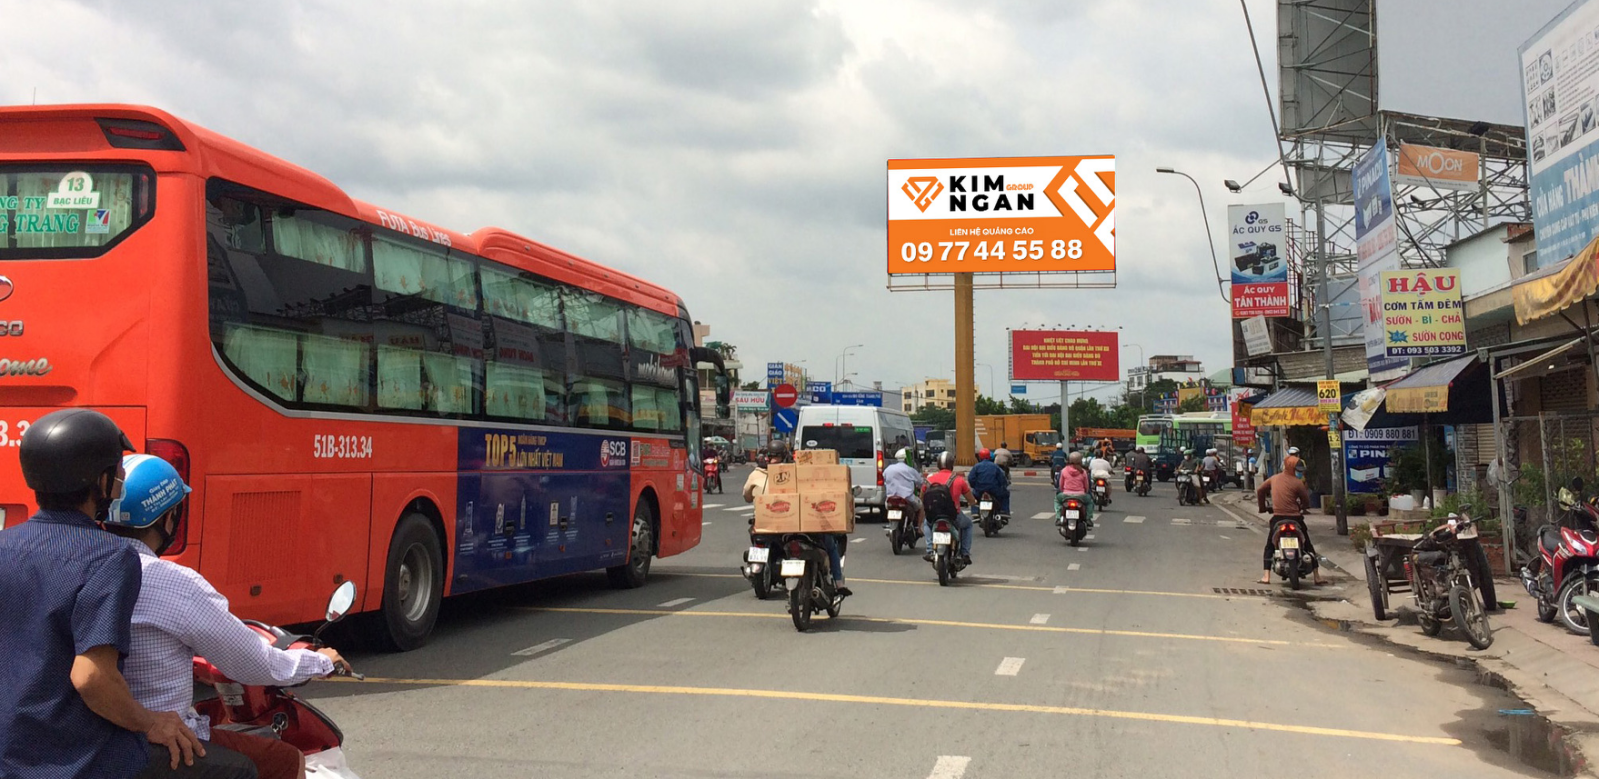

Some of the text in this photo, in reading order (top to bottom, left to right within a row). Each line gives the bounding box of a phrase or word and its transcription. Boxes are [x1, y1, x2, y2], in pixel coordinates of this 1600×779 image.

[67, 177, 85, 192] 13
[949, 174, 1035, 193] KIM GROUP
[24, 196, 45, 209] TY
[53, 197, 71, 207] BẠC
[949, 193, 1034, 212] NGAN
[15, 214, 80, 233] TRANG
[376, 209, 452, 247] FUTA Bus Lines
[1247, 225, 1266, 234] QUY
[1268, 224, 1282, 232] GS
[949, 227, 968, 236] LIÊN
[969, 227, 982, 237] HỆ
[1014, 226, 1034, 236] CÁO
[901, 239, 1083, 262] 09 77 44 55 88
[1387, 271, 1457, 296] HẬU
[1234, 294, 1287, 308] TÂN THÀNH
[1384, 298, 1462, 311] CƠM TẤM ĐÊM
[1421, 313, 1432, 324] BÌ
[1441, 311, 1462, 324] CHẢ
[1439, 331, 1465, 343] CỌNG
[1406, 346, 1423, 355] 093
[1424, 346, 1440, 354] 503
[1441, 345, 1462, 353] 3392
[1318, 388, 1337, 399] 620
[1364, 429, 1384, 439] 0909
[1385, 428, 1400, 438] 880
[1402, 428, 1416, 438] 881
[313, 434, 373, 459] 51B-313.34
[609, 441, 626, 456] SCB
[141, 489, 166, 508] THÀNH
